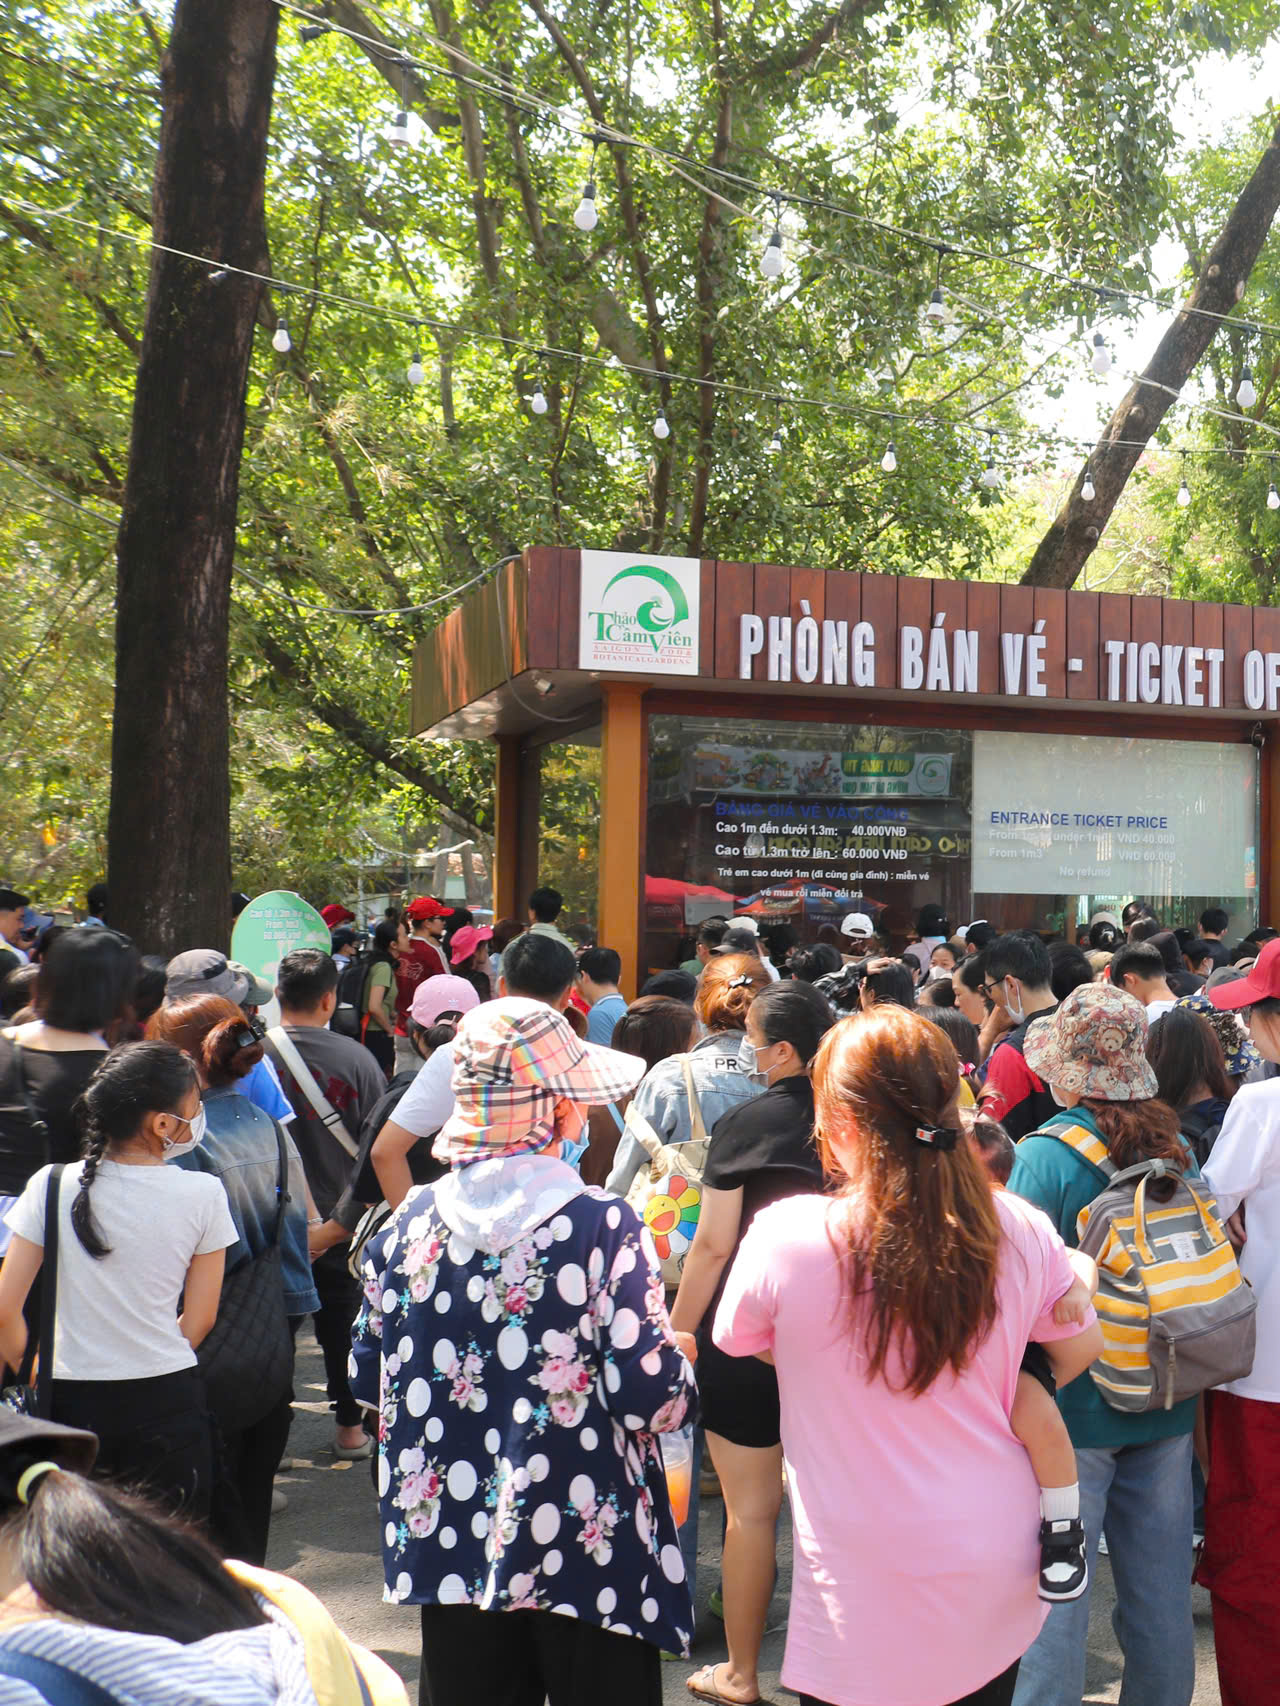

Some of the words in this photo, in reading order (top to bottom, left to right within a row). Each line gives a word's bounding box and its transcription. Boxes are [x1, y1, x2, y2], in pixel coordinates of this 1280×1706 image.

[739, 599, 876, 688] PHÒNG
[900, 612, 979, 693] BÁN
[1001, 619, 1047, 698] VÉ
[1105, 640, 1224, 708] TICKET
[991, 811, 1070, 826] ENTRANCE
[1074, 814, 1123, 828] TICKET
[1127, 816, 1168, 829] PRICE
[716, 821, 738, 833] Cao
[740, 822, 757, 833] 1m
[760, 821, 779, 834] đến
[782, 824, 808, 834] dưới
[715, 844, 740, 856] Cao
[761, 846, 788, 857] 1.3m
[791, 847, 810, 858] trở
[813, 847, 830, 858] lên
[842, 848, 879, 859] 60.000
[882, 849, 908, 860] VNĐ
[850, 871, 864, 880] gia
[1060, 866, 1074, 876] No
